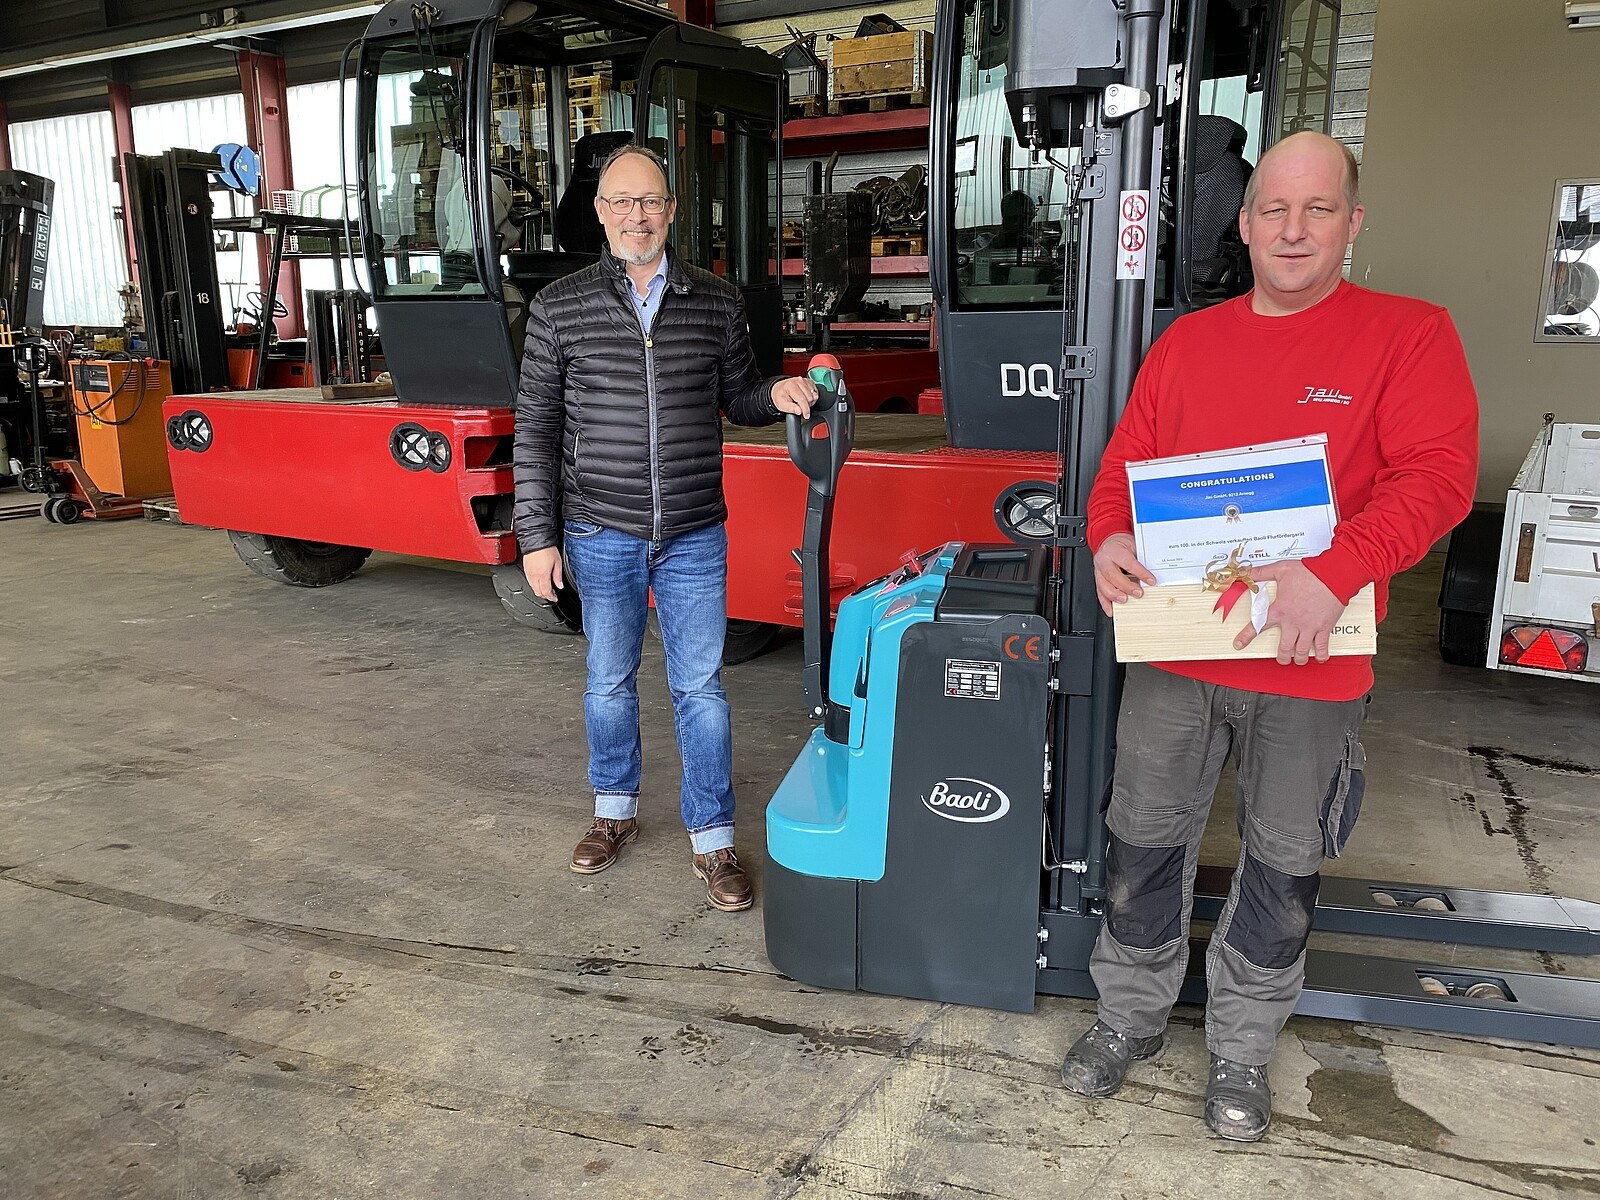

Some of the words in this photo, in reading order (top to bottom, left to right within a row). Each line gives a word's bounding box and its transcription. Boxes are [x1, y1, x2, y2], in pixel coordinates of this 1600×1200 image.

[196, 292, 210, 304] 18
[357, 313, 366, 361] Ranger
[1000, 363, 1061, 401] DQ
[1180, 472, 1275, 489] CONGRATULATIONS
[929, 782, 992, 811] Baoli
